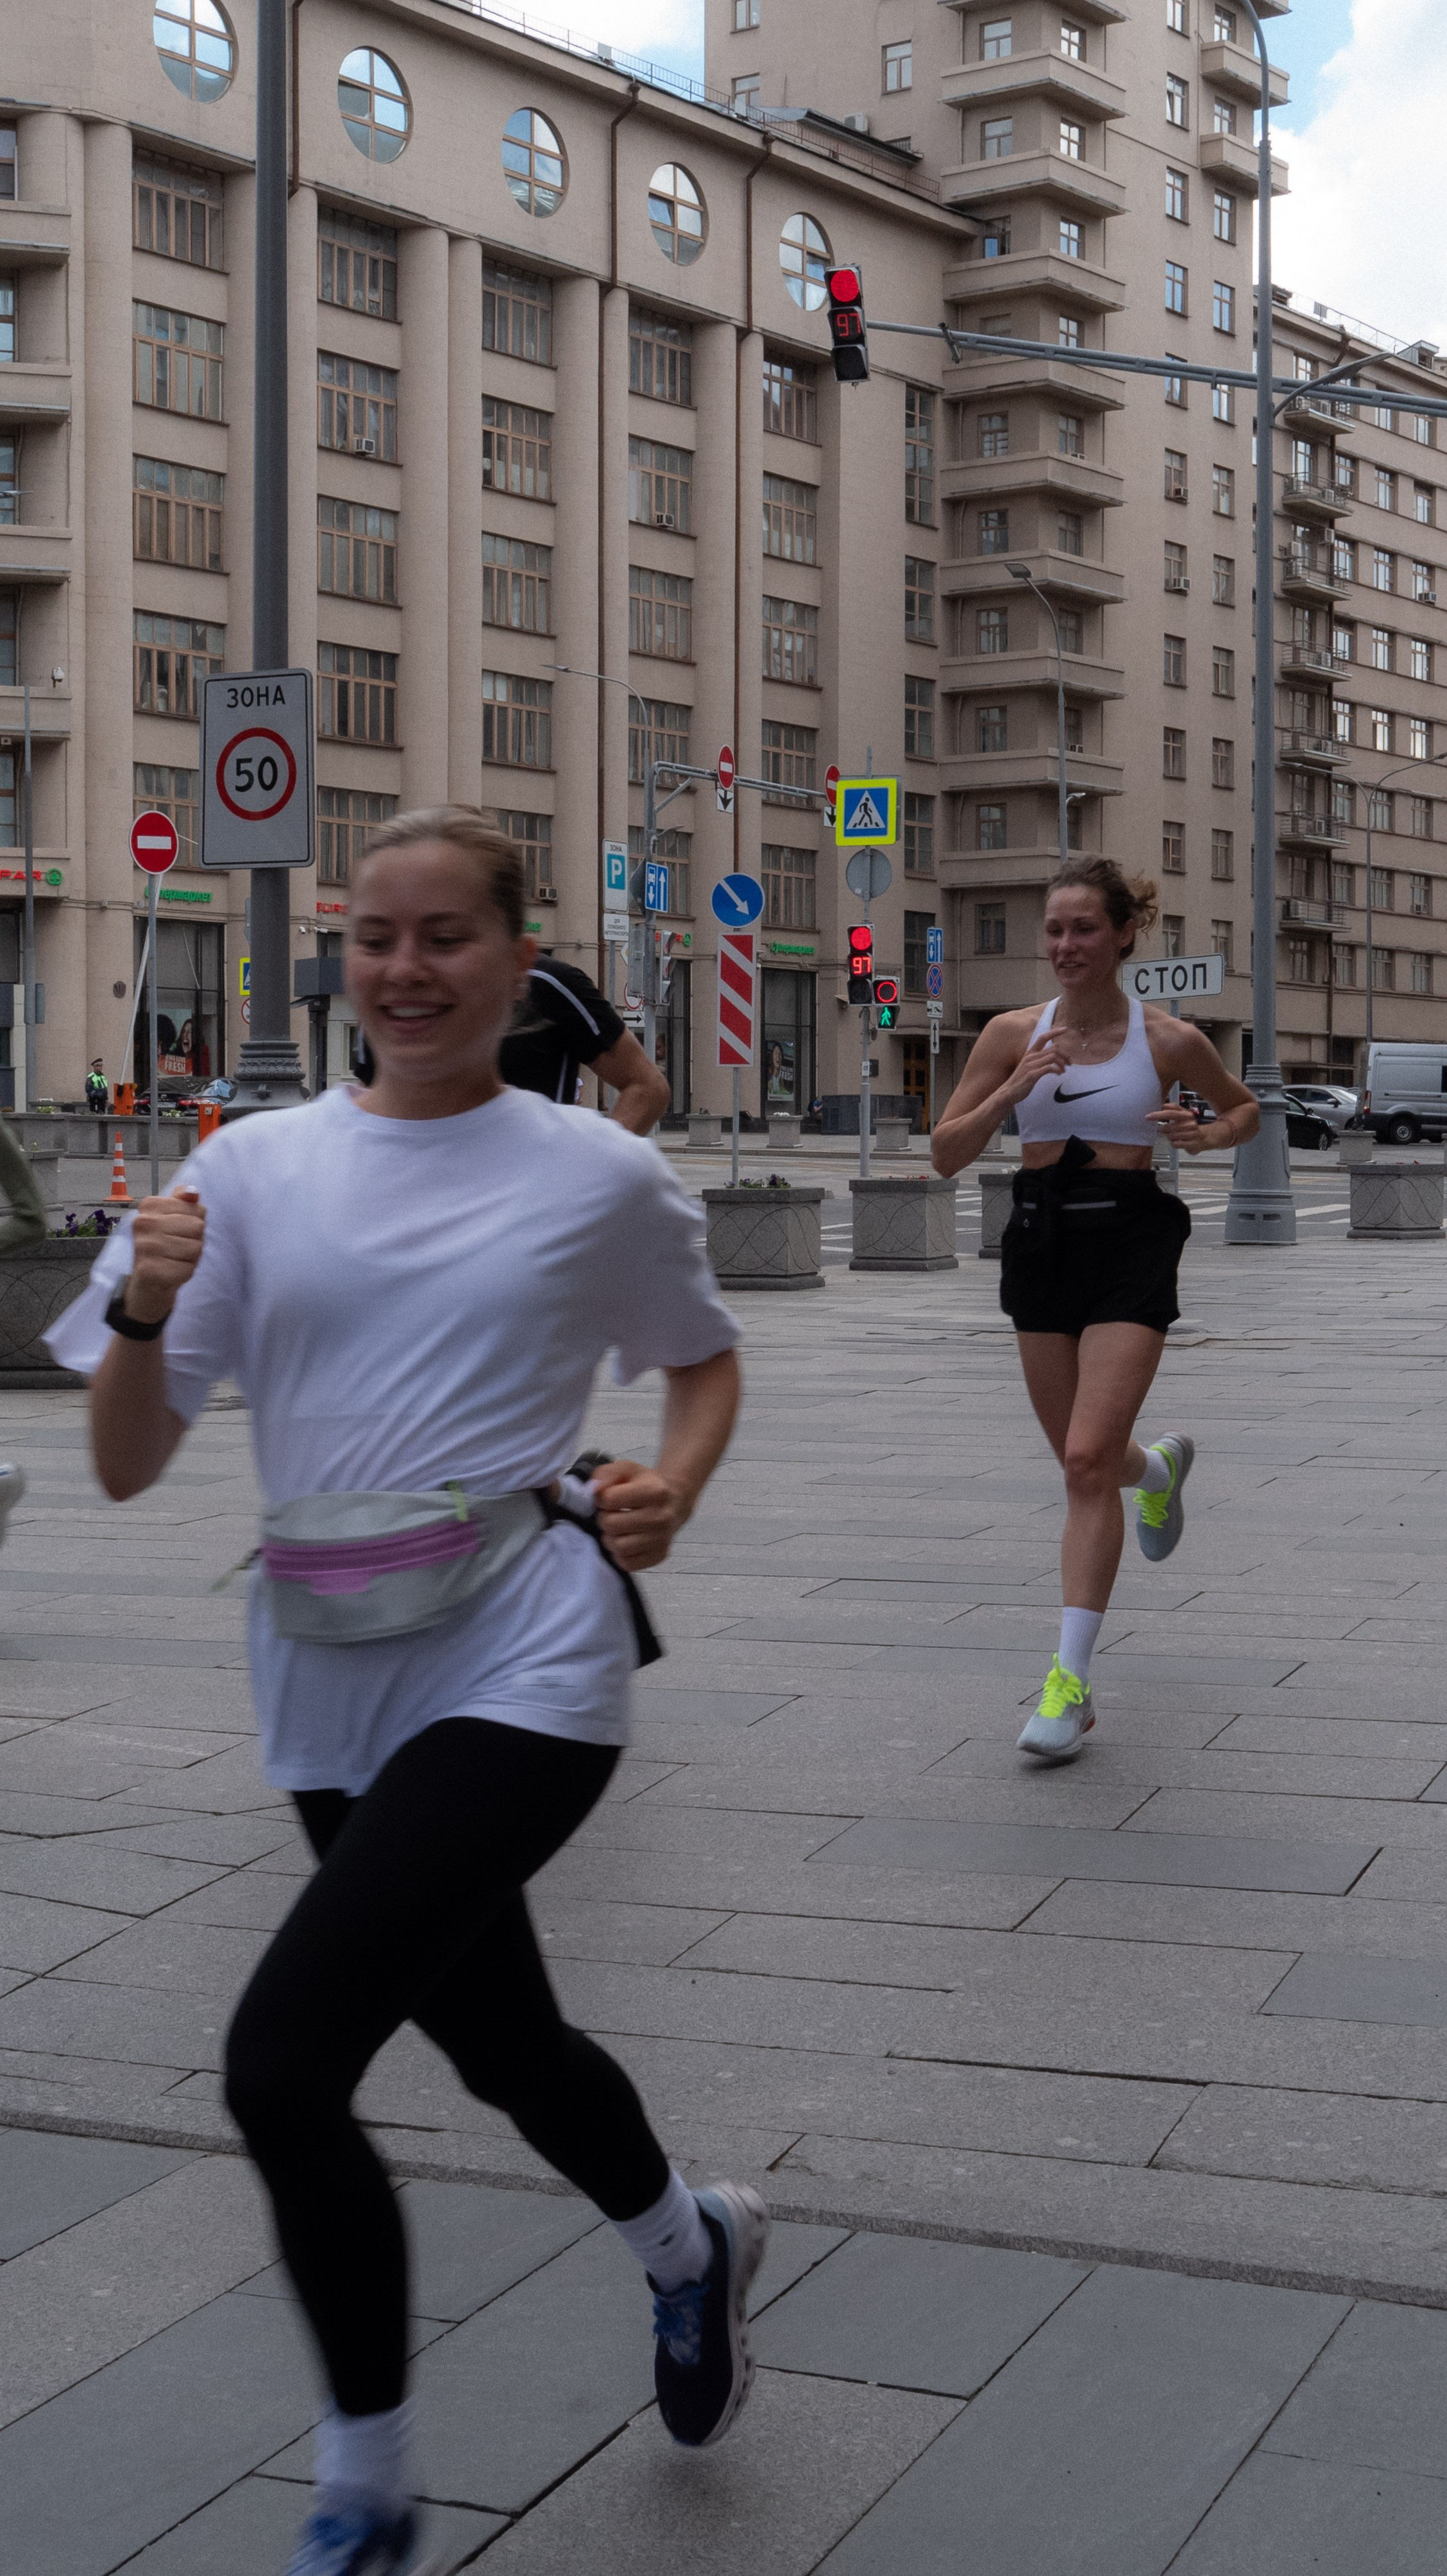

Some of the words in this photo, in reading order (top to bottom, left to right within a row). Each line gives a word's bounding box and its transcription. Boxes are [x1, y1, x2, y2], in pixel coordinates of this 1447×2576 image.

[836, 312, 861, 337] 97
[226, 684, 286, 708] ЗОНА
[235, 756, 278, 793] 50
[609, 844, 623, 852] ЗОНА
[611, 858, 622, 884] P
[852, 956, 872, 974] 97
[1135, 963, 1207, 995] СТОП
[164, 1059, 186, 1073] FRESH
